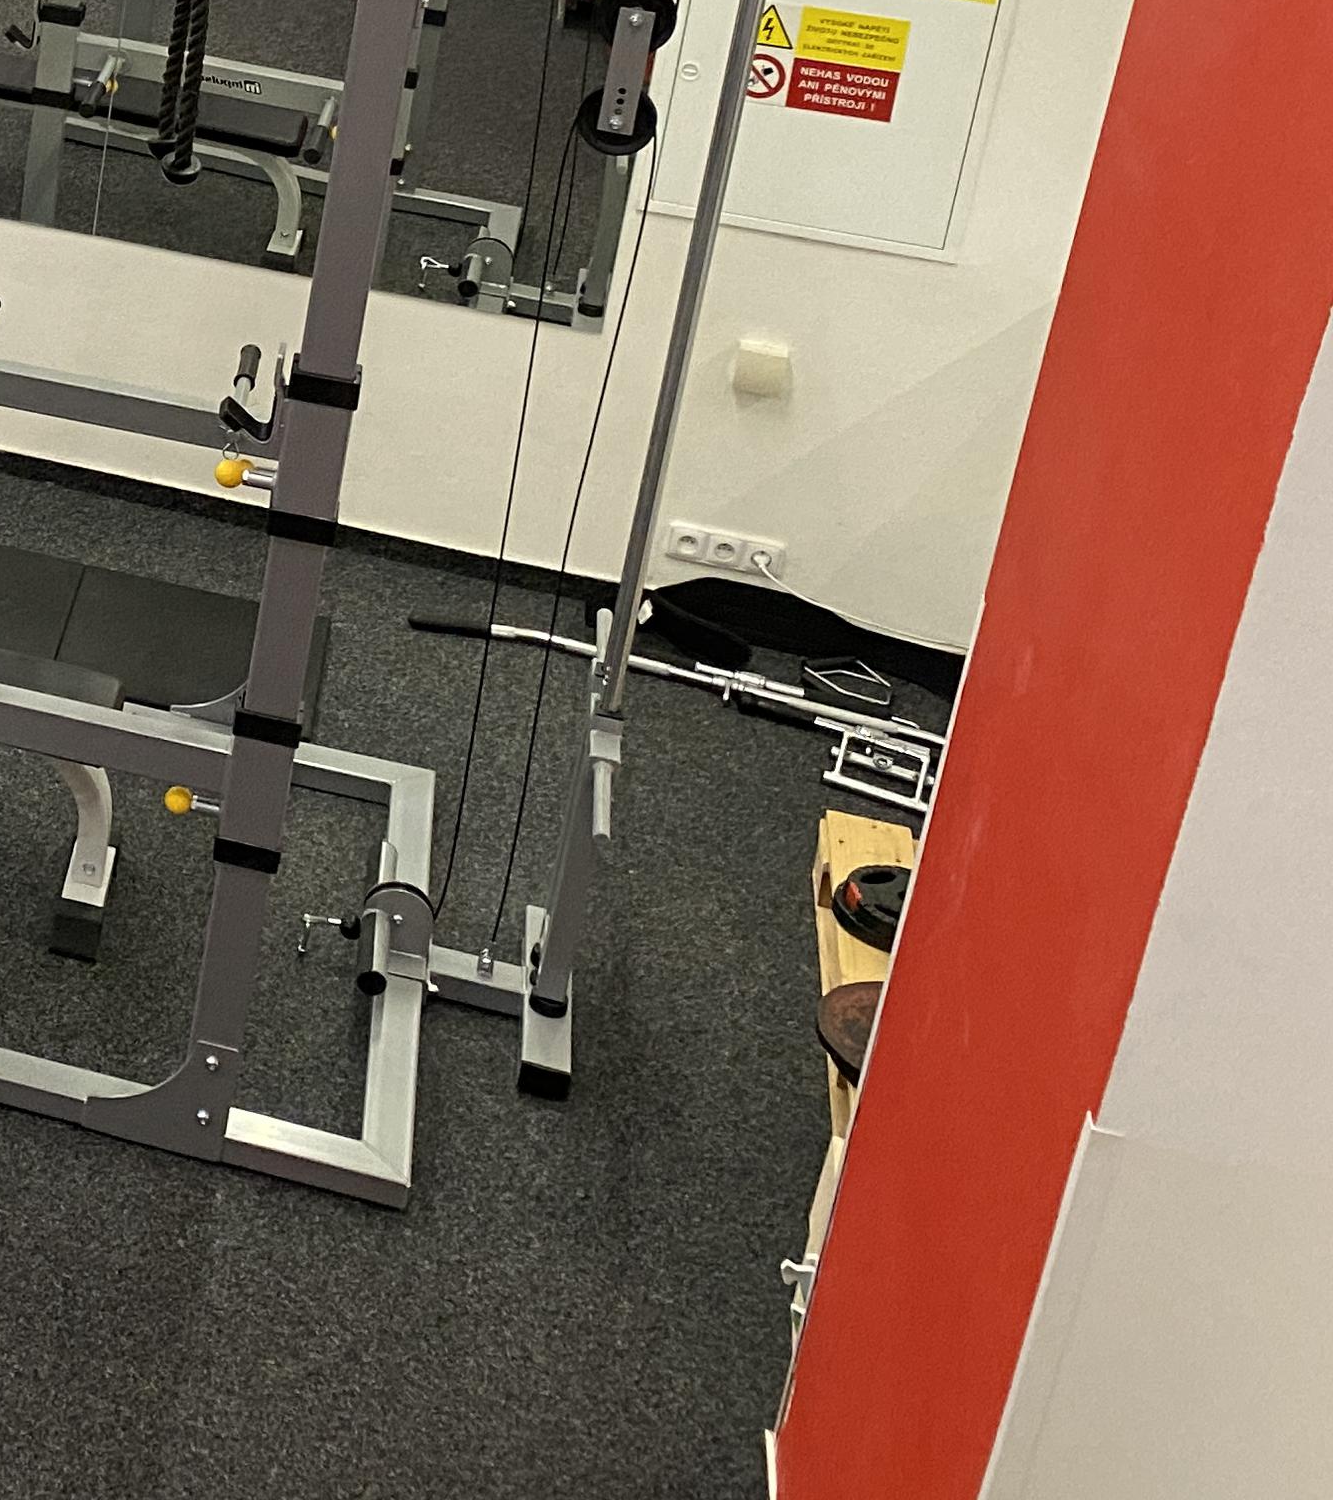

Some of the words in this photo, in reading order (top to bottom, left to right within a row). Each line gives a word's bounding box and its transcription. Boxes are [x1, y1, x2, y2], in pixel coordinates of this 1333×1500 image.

[797, 79, 820, 91] ANI
[799, 67, 841, 80] NEHAS
[846, 73, 890, 87] VODOU
